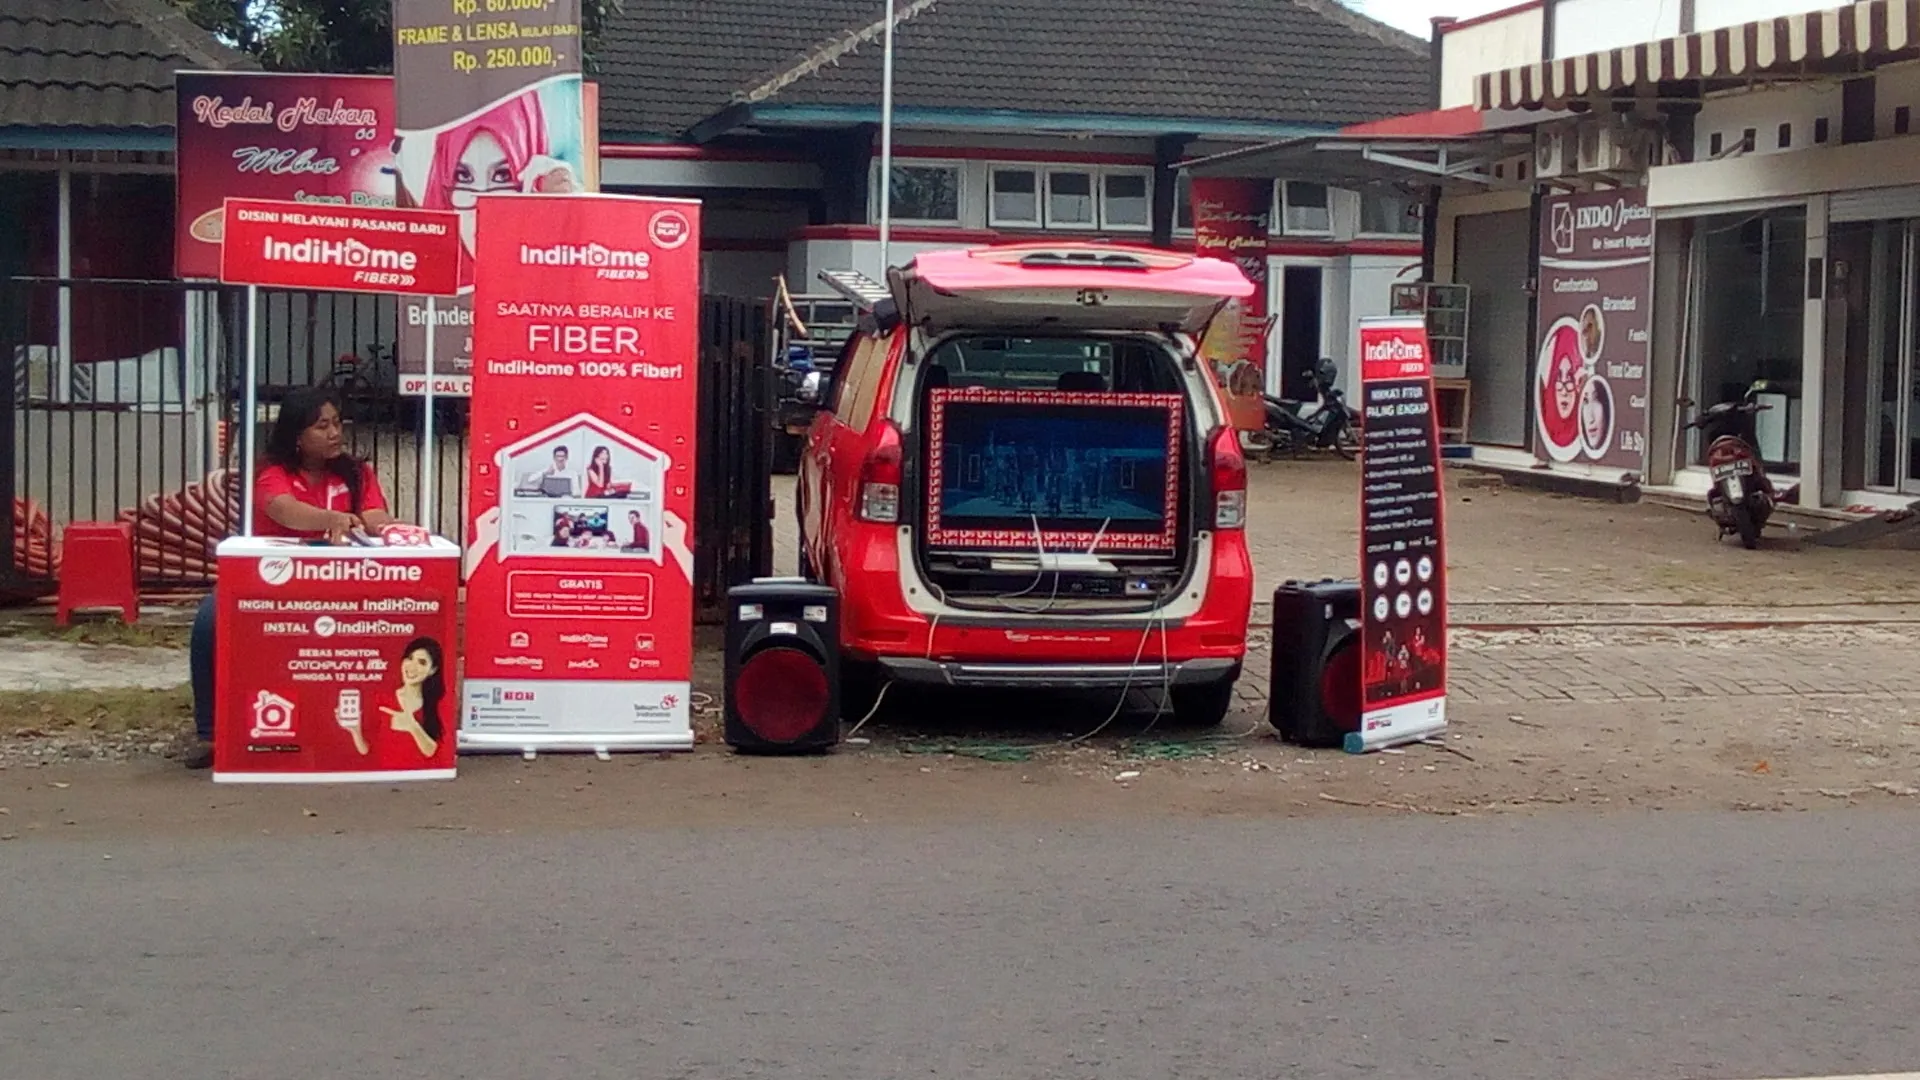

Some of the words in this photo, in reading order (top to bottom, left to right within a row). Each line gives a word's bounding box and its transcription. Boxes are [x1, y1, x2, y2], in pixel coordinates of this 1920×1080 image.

[398, 26, 448, 45] FRAME
[452, 25, 462, 42] &
[466, 22, 519, 41] LENSA
[453, 51, 481, 74] Rp.
[193, 95, 274, 128] Kedai
[277, 97, 377, 132] Makan
[238, 209, 279, 223] DISINI
[282, 213, 349, 229] MELAYANI
[352, 218, 405, 232] PASANG
[409, 223, 446, 235] BARU
[1576, 205, 1612, 229] INDO
[264, 235, 417, 270] IndiHome
[520, 242, 650, 267] IndiHome
[497, 302, 574, 317] SAATNYA
[579, 305, 649, 320] BERALIH
[653, 307, 675, 320] KE
[488, 360, 575, 376] IndiHome
[579, 362, 627, 377] 100%
[632, 363, 682, 379] Fiber!
[296, 558, 422, 581] IndiHome
[559, 579, 603, 590] GRATIS
[238, 600, 275, 610] INGIN
[277, 600, 358, 611] LANGGANAN
[363, 598, 440, 612] IndiHome
[263, 622, 309, 633] INSTAL
[337, 620, 414, 634] IndiHome
[335, 649, 380, 657] NONTON
